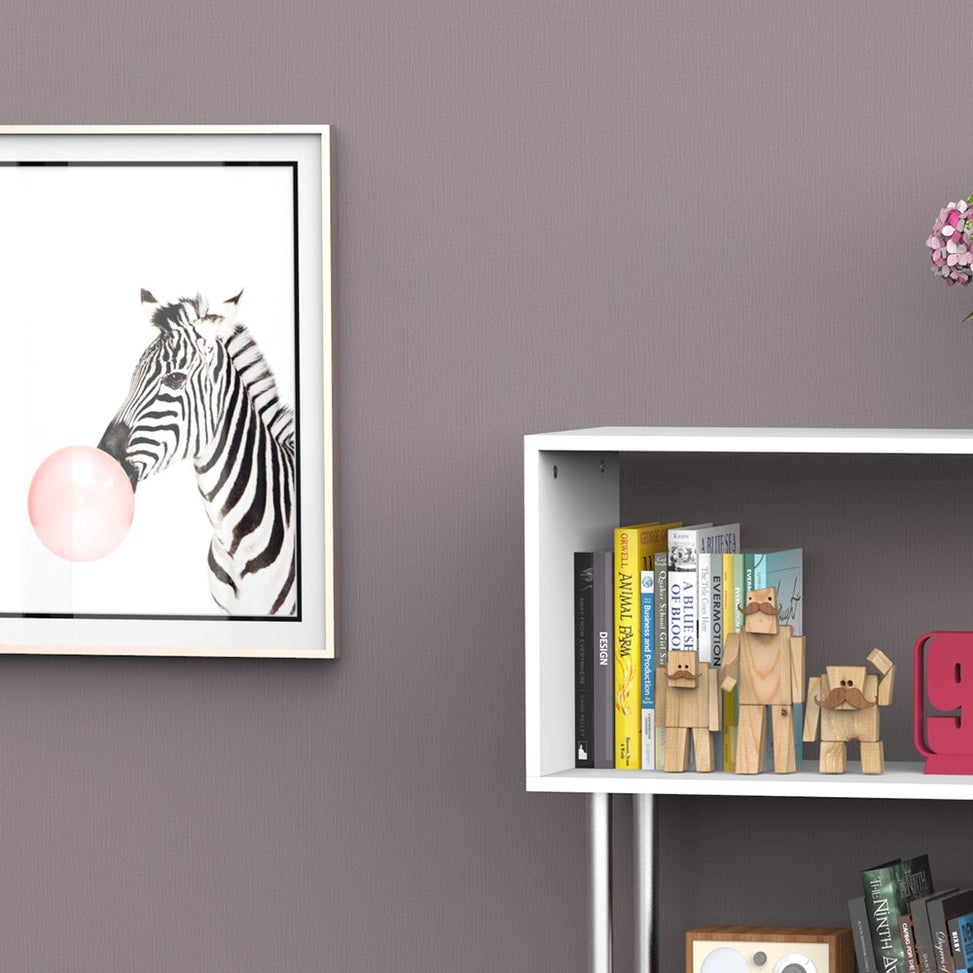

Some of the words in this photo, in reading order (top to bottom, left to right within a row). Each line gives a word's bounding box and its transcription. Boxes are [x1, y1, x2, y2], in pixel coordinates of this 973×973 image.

[620, 532, 629, 569] ORWELL
[618, 572, 633, 621] ANIMAL
[671, 584, 681, 603] OF
[683, 582, 694, 591] A
[644, 605, 653, 637] Business
[683, 596, 694, 632] BLUE
[713, 576, 721, 667] EVERMOTION
[599, 631, 608, 666] DESIGN
[618, 625, 634, 658] FARM
[644, 639, 653, 652] and
[644, 654, 653, 696] Production
[951, 931, 961, 952] BIXBY
